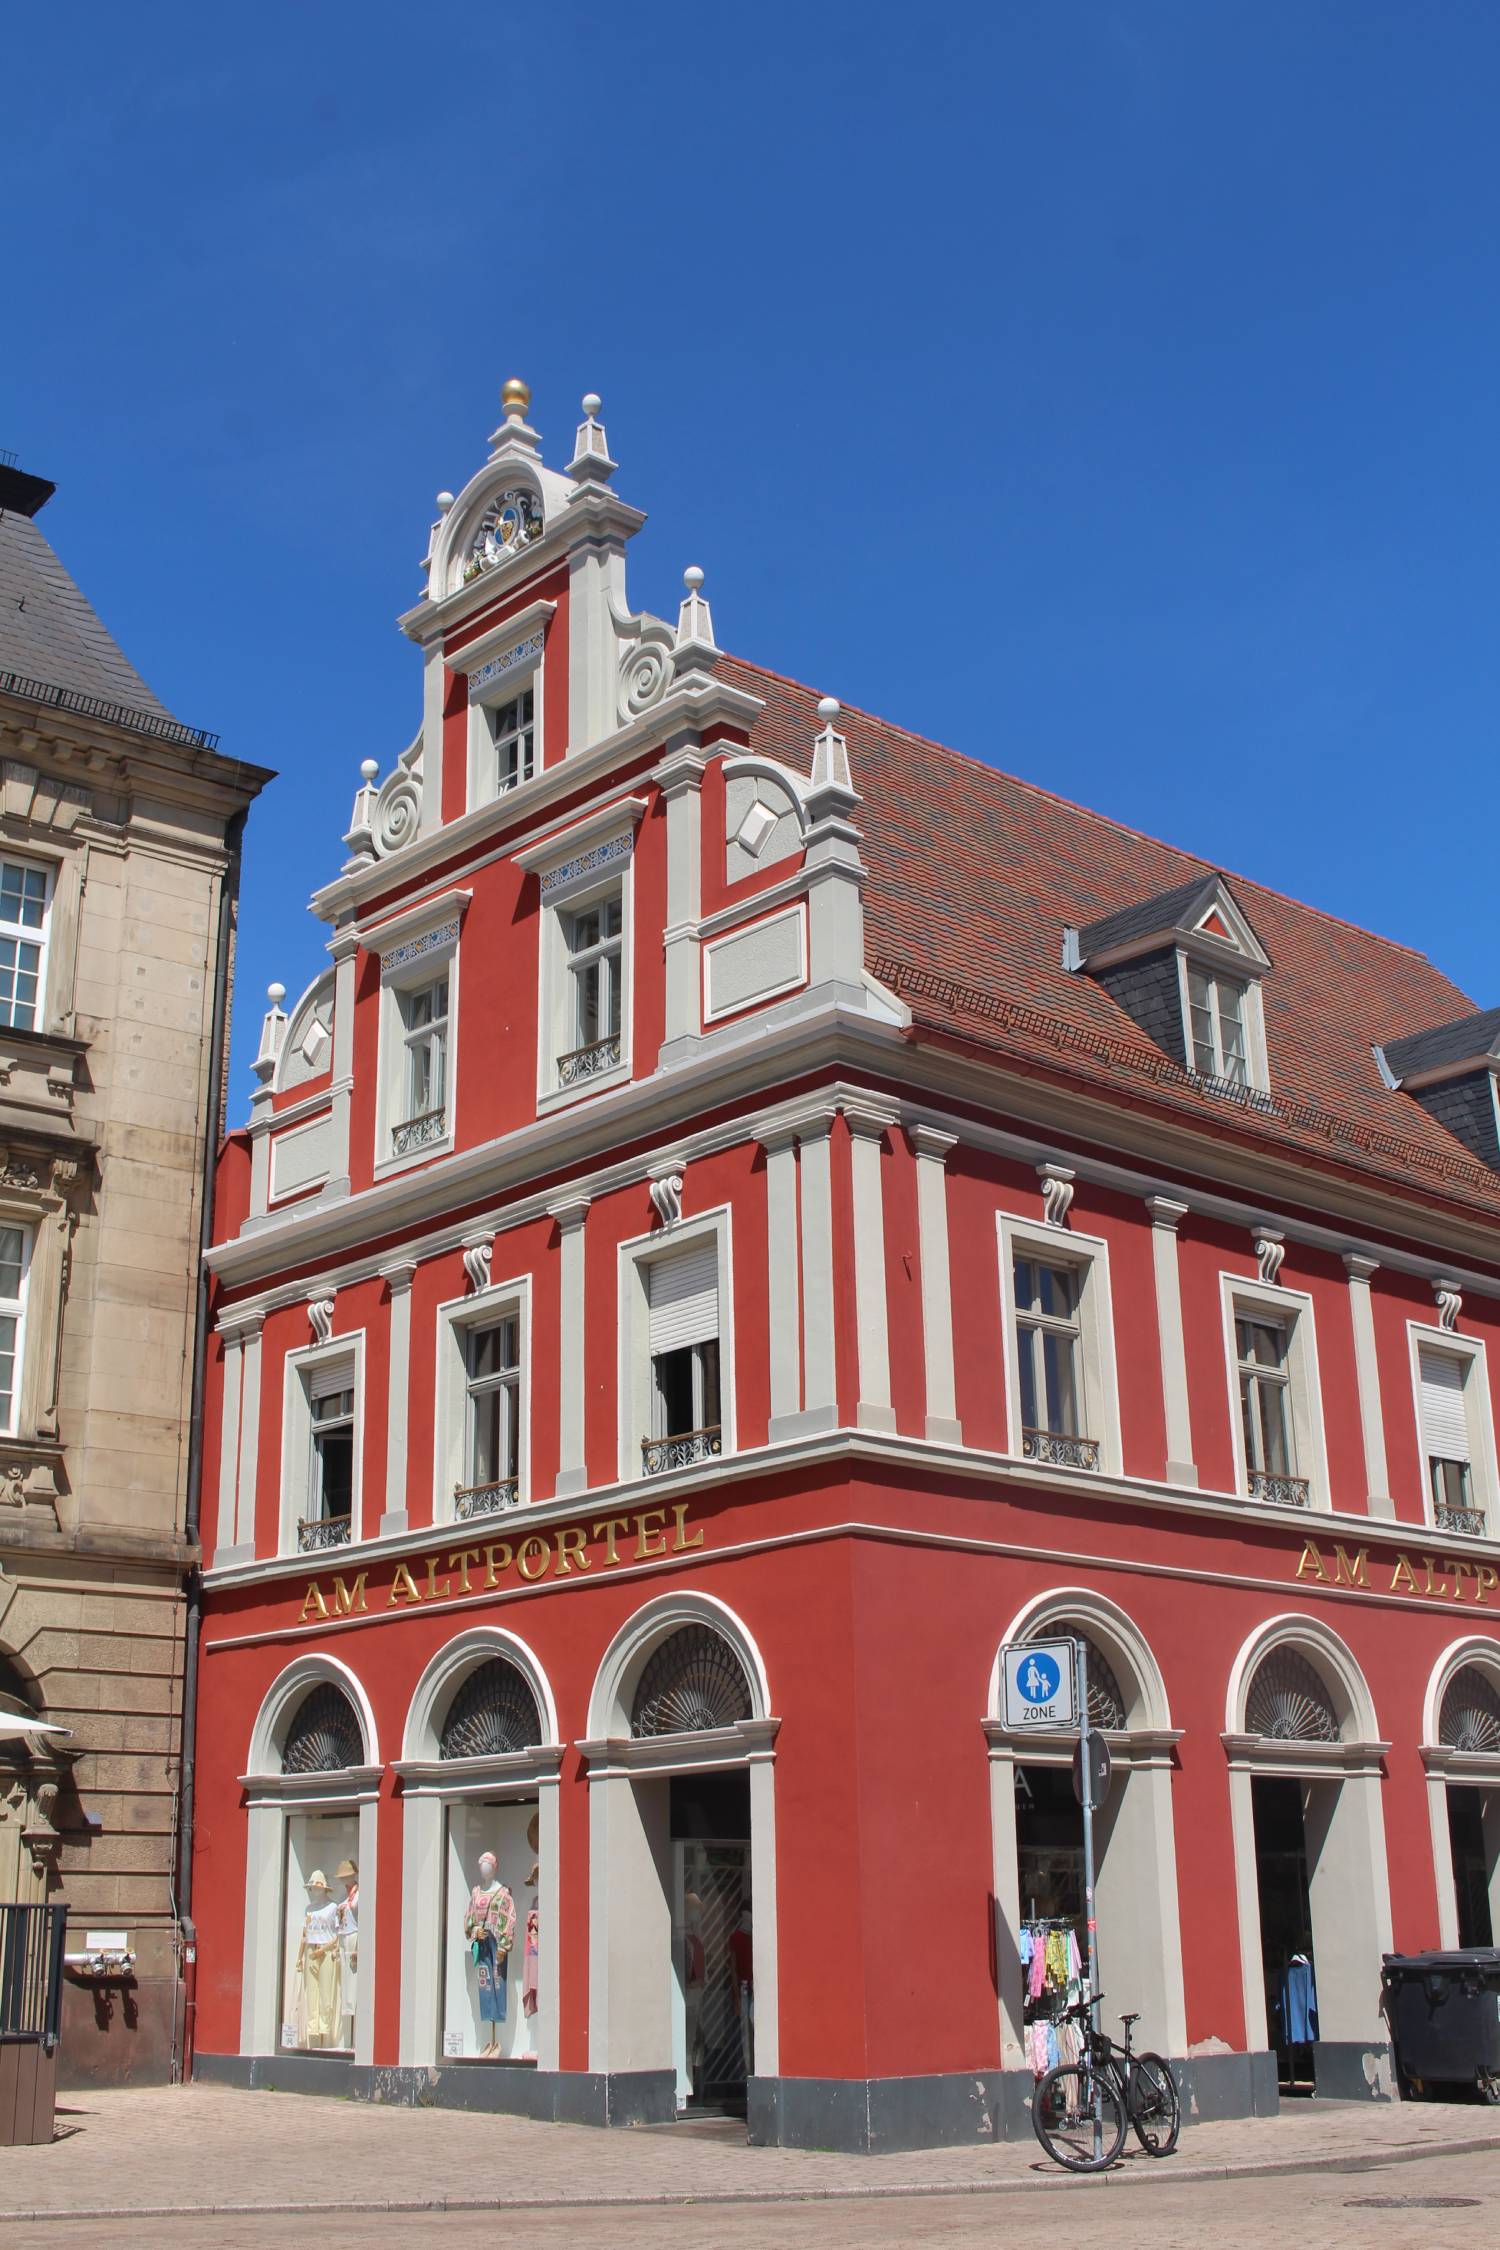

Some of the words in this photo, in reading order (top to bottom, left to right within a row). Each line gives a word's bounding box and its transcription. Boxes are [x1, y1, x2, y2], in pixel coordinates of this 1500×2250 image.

[1295, 1539, 1371, 1588] AM
[298, 1571, 369, 1622] AM
[1023, 1705, 1057, 1720] ZONE
